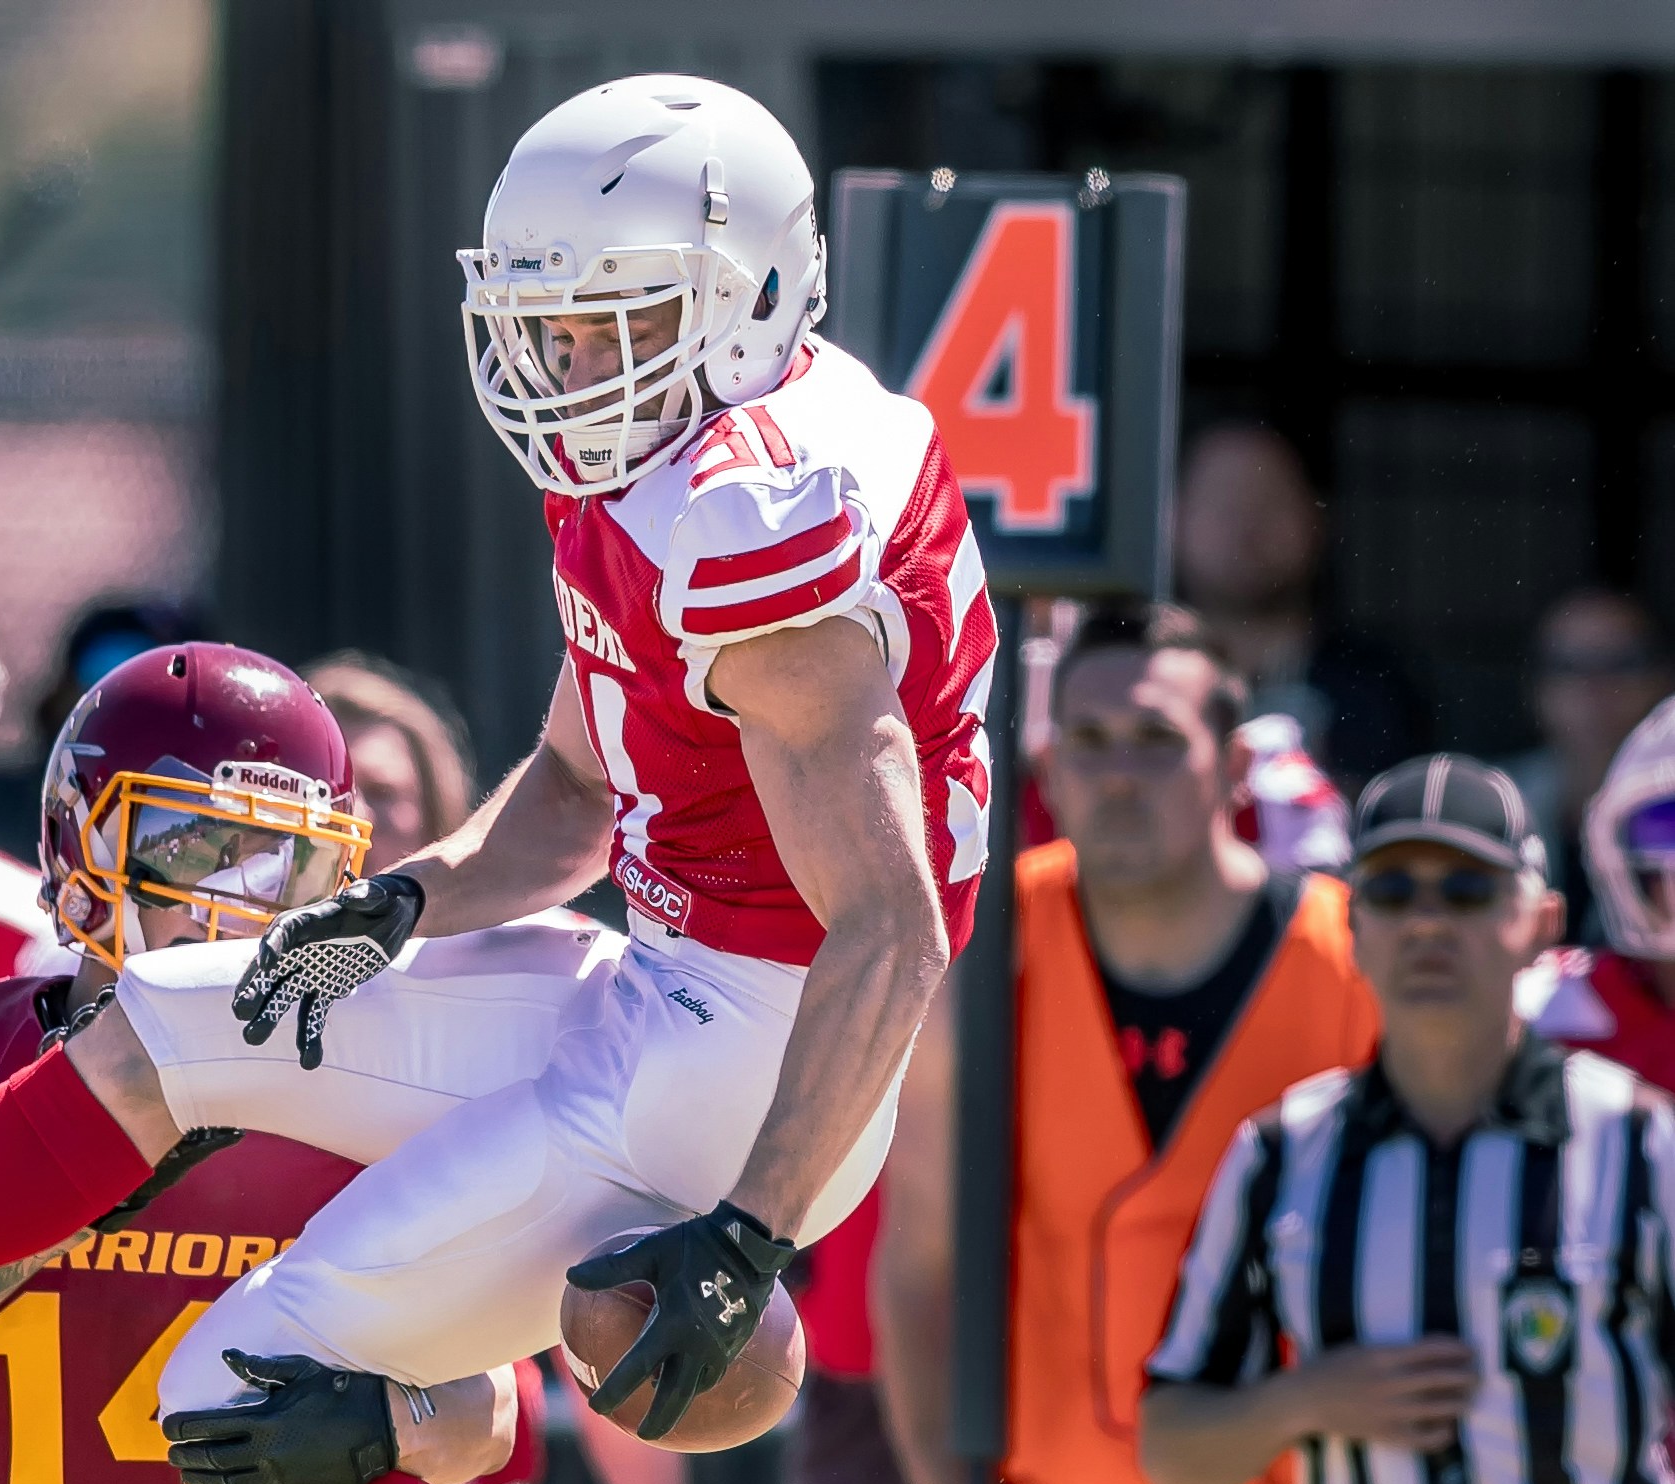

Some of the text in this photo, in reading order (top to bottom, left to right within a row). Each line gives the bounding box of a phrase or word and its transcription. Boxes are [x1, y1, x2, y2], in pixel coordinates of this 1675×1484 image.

[510, 256, 542, 271] schutt
[902, 201, 1100, 533] 4
[578, 447, 613, 462] schutt
[240, 768, 300, 794] Riddell
[624, 865, 683, 918] SHOC
